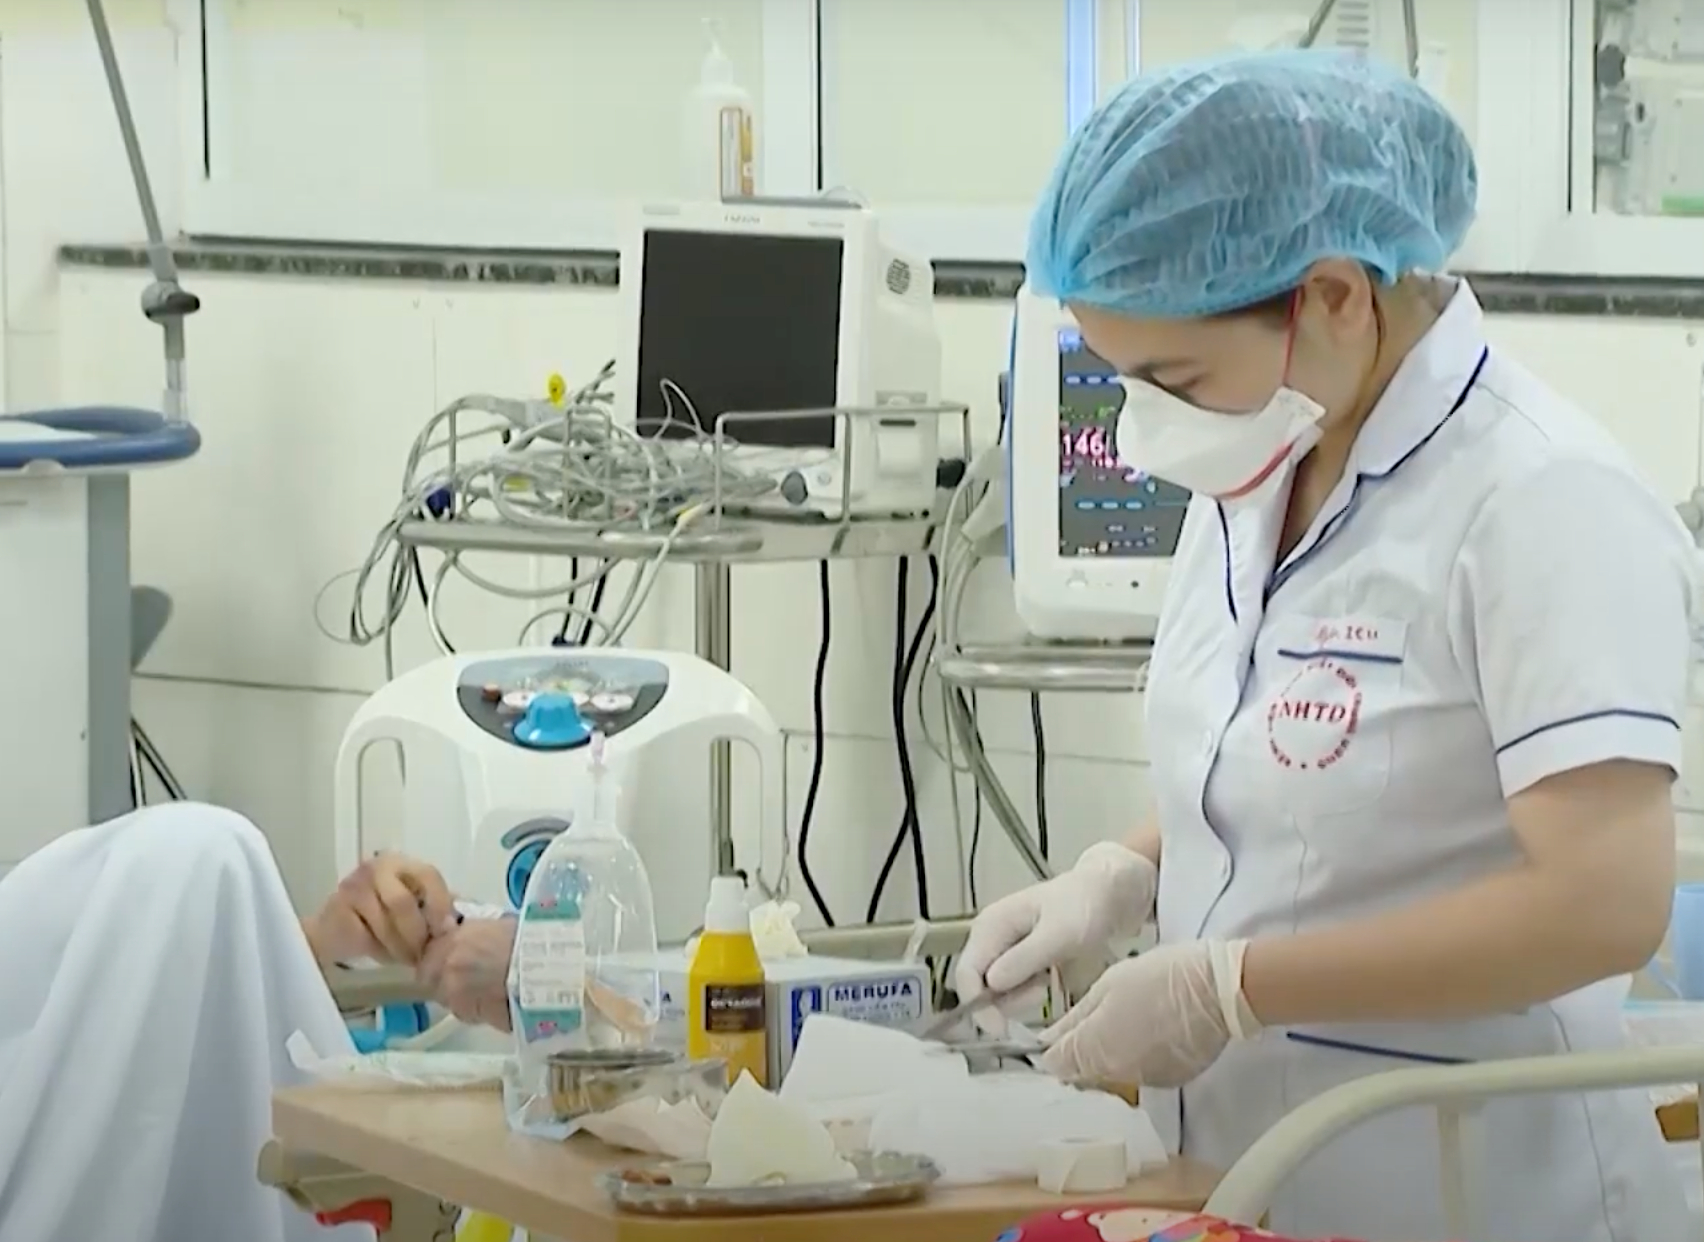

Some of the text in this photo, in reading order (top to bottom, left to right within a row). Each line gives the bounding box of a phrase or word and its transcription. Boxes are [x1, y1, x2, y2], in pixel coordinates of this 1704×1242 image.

[1063, 431, 1104, 456] 146
[1279, 701, 1346, 722] NHTD
[834, 982, 913, 1002] MERUFA
